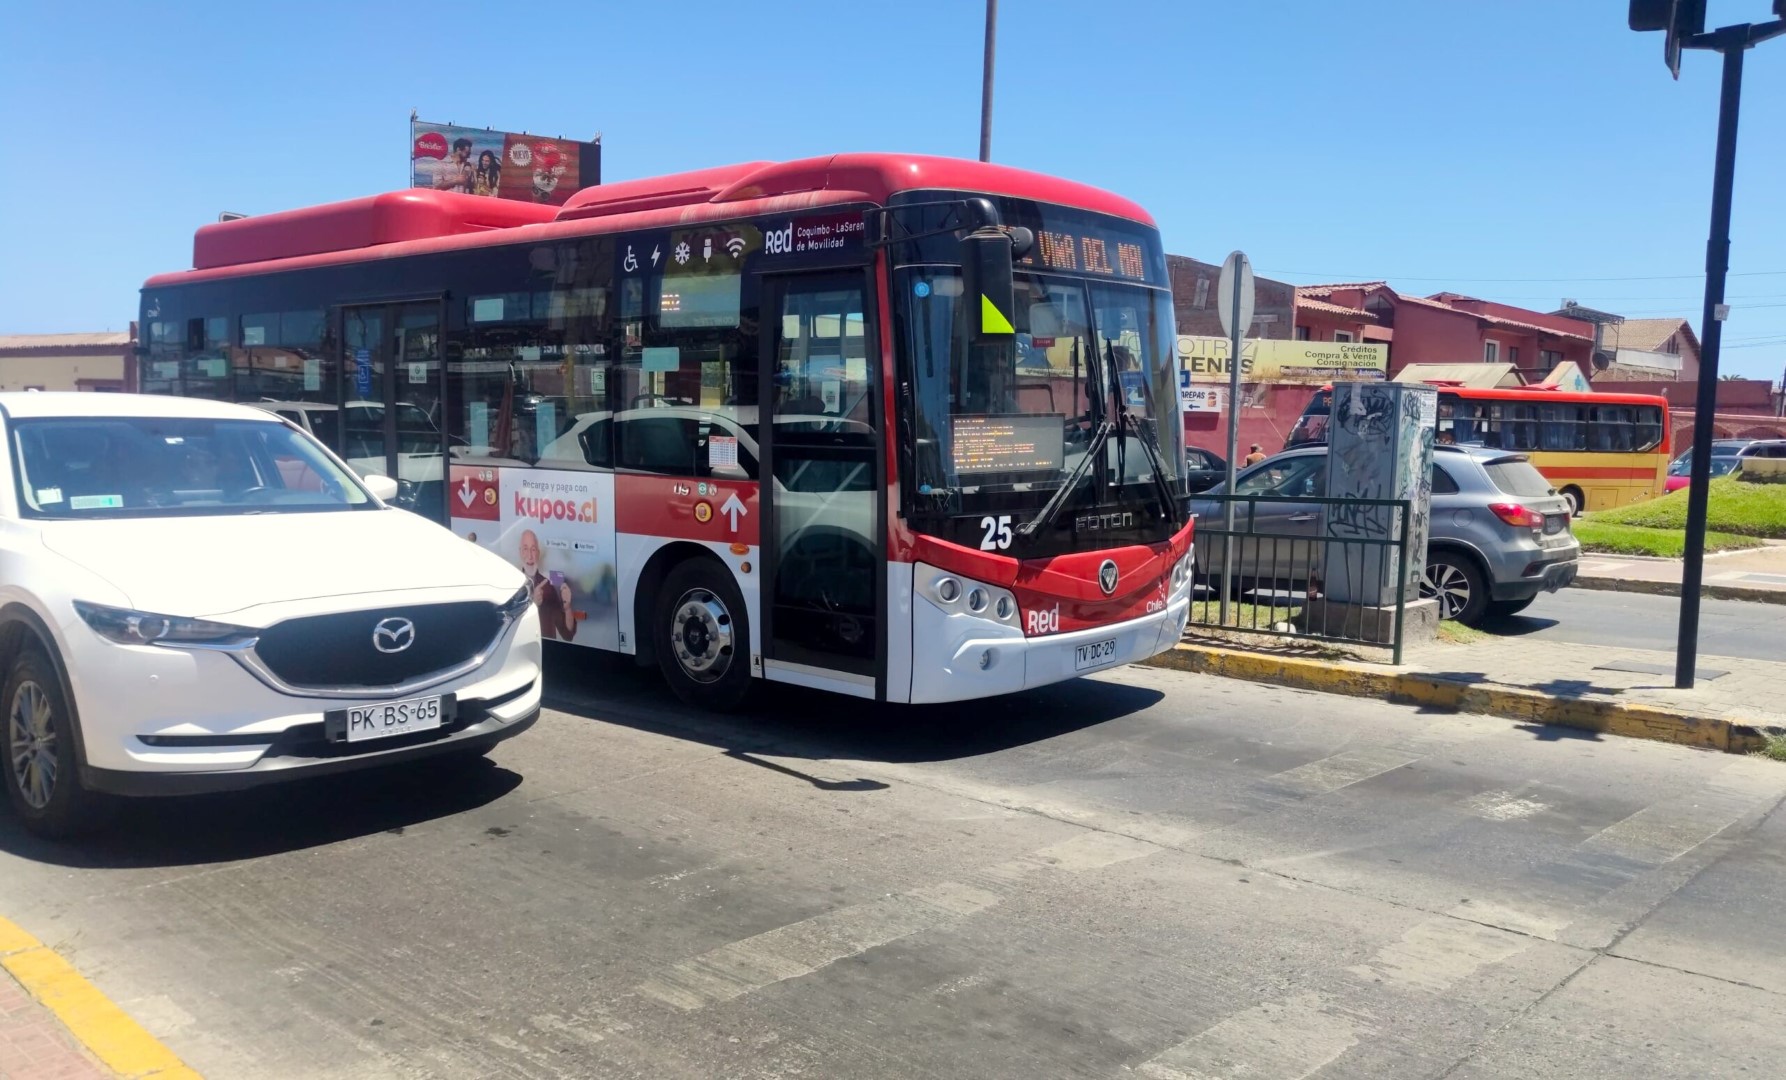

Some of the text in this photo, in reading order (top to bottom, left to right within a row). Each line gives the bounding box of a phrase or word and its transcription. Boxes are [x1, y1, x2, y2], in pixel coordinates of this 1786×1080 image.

[765, 222, 793, 254] Red
[797, 224, 831, 239] Coquimbo
[836, 221, 865, 233] LaSeren
[796, 236, 844, 252] de Movilidad
[1081, 237, 1113, 274] DEL
[1304, 350, 1341, 360] Compra
[1352, 353, 1377, 361] Venta
[1340, 345, 1378, 354] Créditos
[1316, 359, 1378, 368] Consignación
[522, 480, 588, 494] Recarga y paga con
[514, 491, 598, 525] kupos.cl
[980, 515, 1013, 550] 25
[1146, 598, 1164, 613] Chile
[1027, 602, 1060, 634] Red
